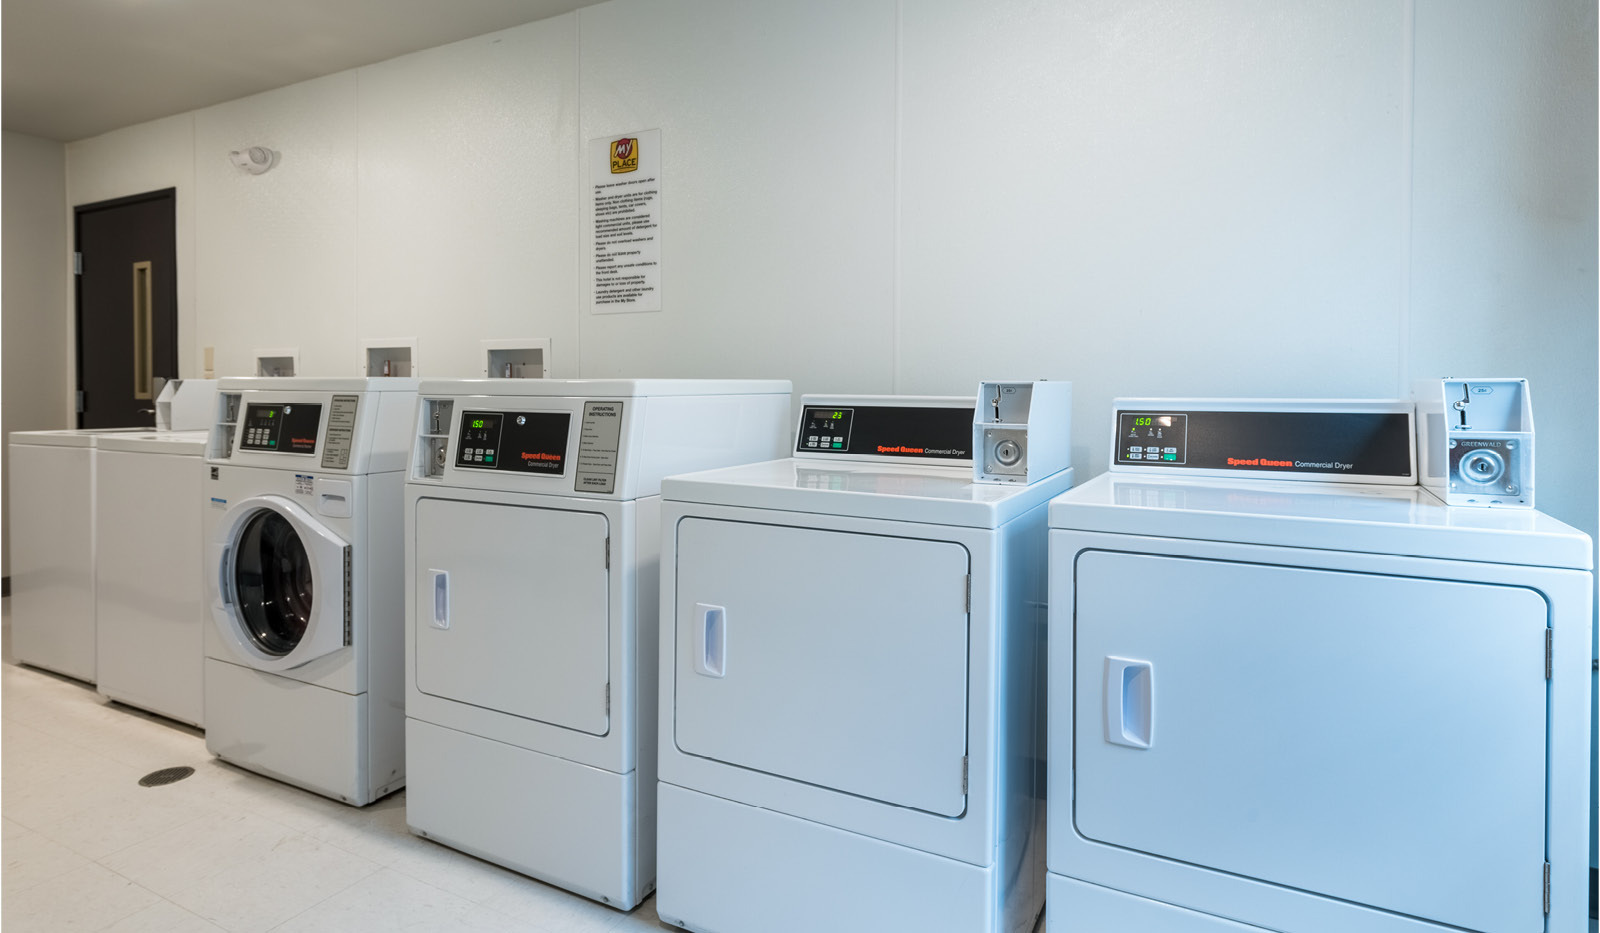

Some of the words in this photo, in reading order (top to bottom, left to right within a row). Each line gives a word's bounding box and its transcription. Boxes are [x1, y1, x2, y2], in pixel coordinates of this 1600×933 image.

[615, 139, 632, 157] MY
[612, 158, 637, 169] PLACE
[877, 445, 900, 453] Speed
[521, 452, 541, 460] Speed
[541, 452, 561, 460] Queen
[527, 460, 548, 468] Commercial
[548, 461, 560, 469] Dryer
[1227, 457, 1259, 466] Speed
[1260, 458, 1293, 467] Queen
[1294, 460, 1334, 469] Commercial
[1334, 462, 1353, 470] Dryer
